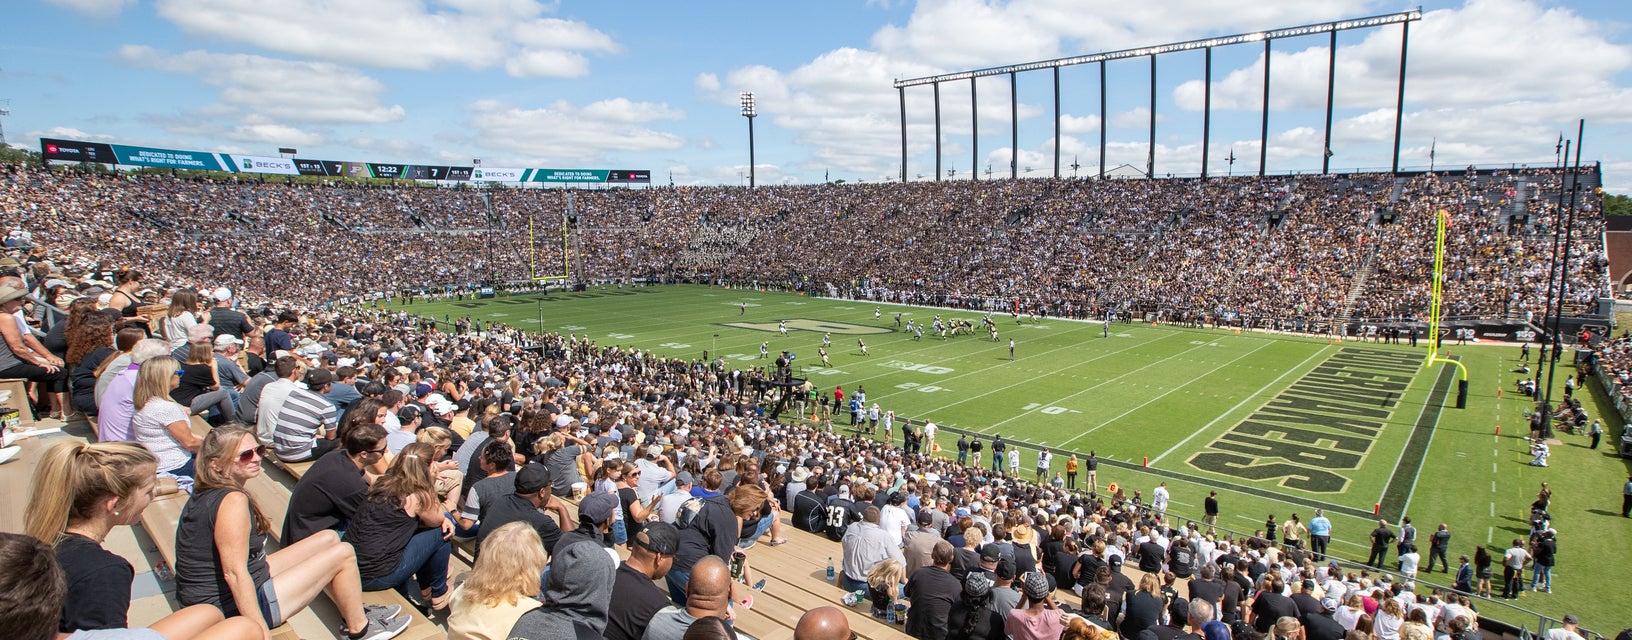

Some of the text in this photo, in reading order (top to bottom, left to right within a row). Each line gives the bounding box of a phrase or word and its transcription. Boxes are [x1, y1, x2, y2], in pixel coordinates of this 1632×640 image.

[256, 161, 291, 169] BECK'S
[335, 164, 342, 173] 7
[431, 169, 438, 177] 7
[895, 382, 943, 392] 20
[1021, 402, 1068, 414] 10
[826, 505, 844, 527] 33
